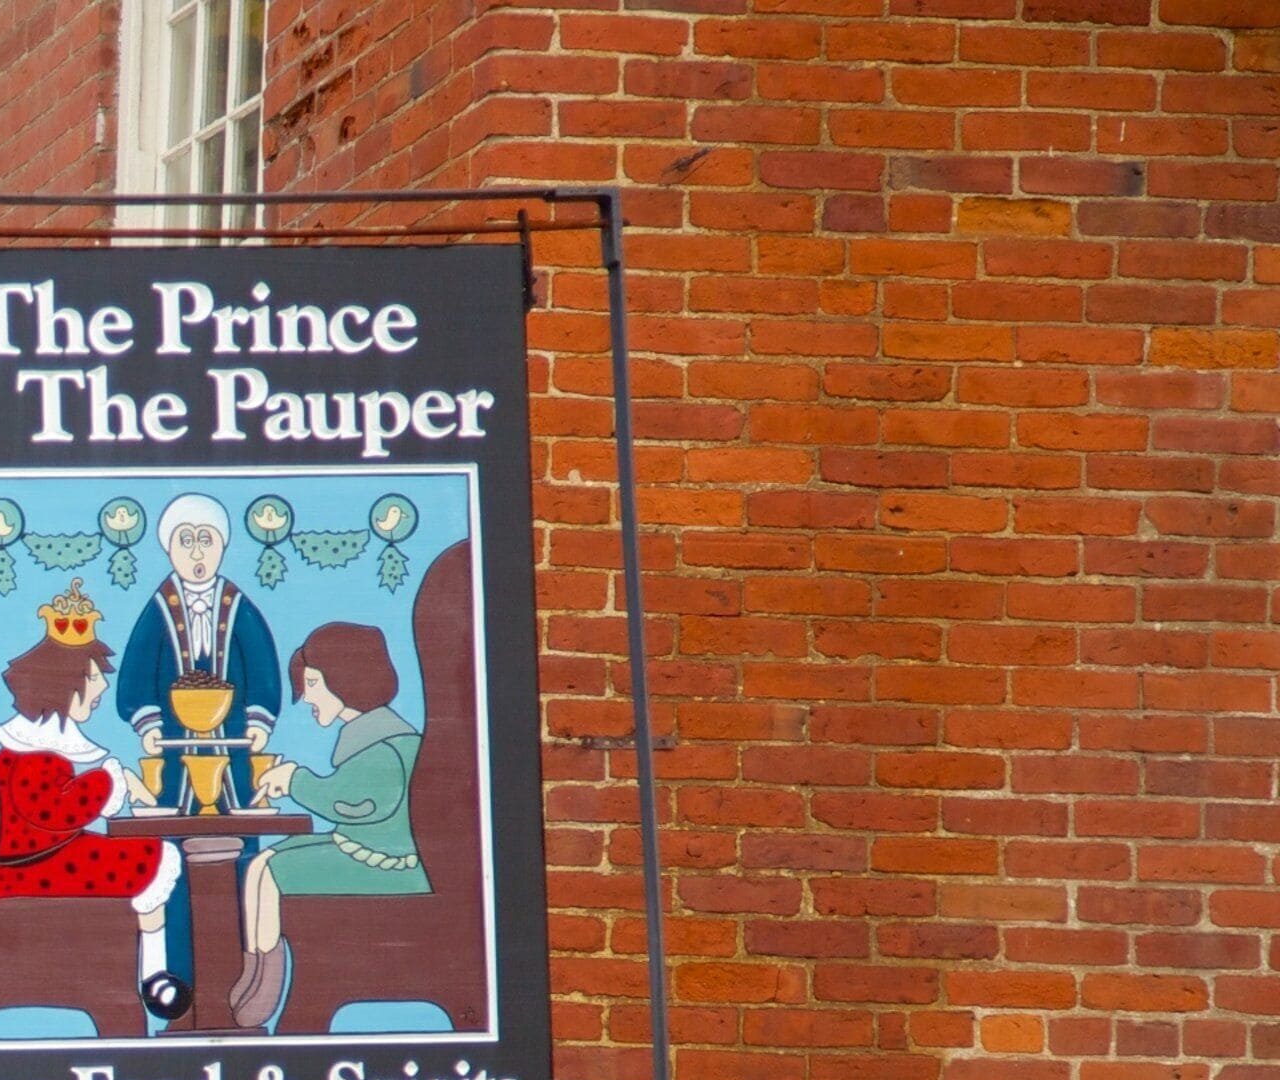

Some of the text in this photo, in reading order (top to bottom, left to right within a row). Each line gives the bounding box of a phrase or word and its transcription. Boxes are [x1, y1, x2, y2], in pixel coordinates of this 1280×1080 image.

[152, 281, 418, 354] Prince
[17, 366, 189, 442] The
[207, 367, 495, 458] Pauper
